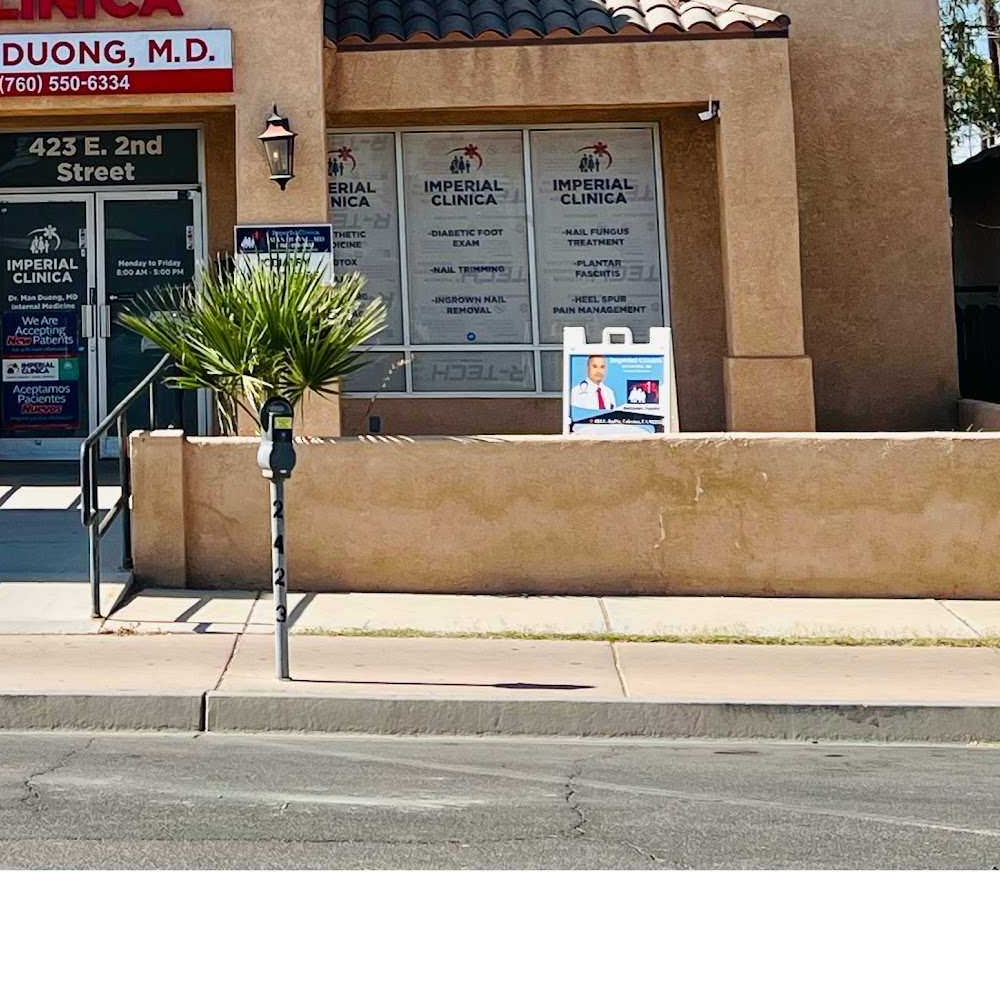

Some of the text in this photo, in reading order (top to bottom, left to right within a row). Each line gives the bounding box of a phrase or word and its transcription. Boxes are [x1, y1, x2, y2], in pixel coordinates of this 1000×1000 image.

[2, 40, 136, 68] DUONG,
[148, 38, 216, 64] M.D.
[48, 74, 130, 92] 550-6334
[29, 135, 162, 157] 423 E. 2nd
[57, 162, 135, 182] Street
[328, 182, 376, 194] ERIAL
[424, 180, 504, 193] IMPERIAL
[553, 178, 633, 191] IMPERIAL
[331, 196, 370, 208] NICA
[431, 194, 497, 206] CLINICA
[560, 192, 627, 205] CLINICA
[7, 258, 78, 271] IMPERIAL
[458, 265, 505, 273] TRIMMING
[13, 271, 72, 284] CLINICA
[484, 295, 506, 303] NAIL
[602, 295, 627, 303] SPUR
[578, 306, 646, 314] MANAGEMENT
[22, 316, 58, 325] We Are
[15, 326, 66, 337] Accepting
[6, 335, 74, 346] New Patients
[13, 385, 70, 395] Aceptamos
[18, 395, 66, 404] Pacientes
[21, 404, 62, 414] Nuevos
